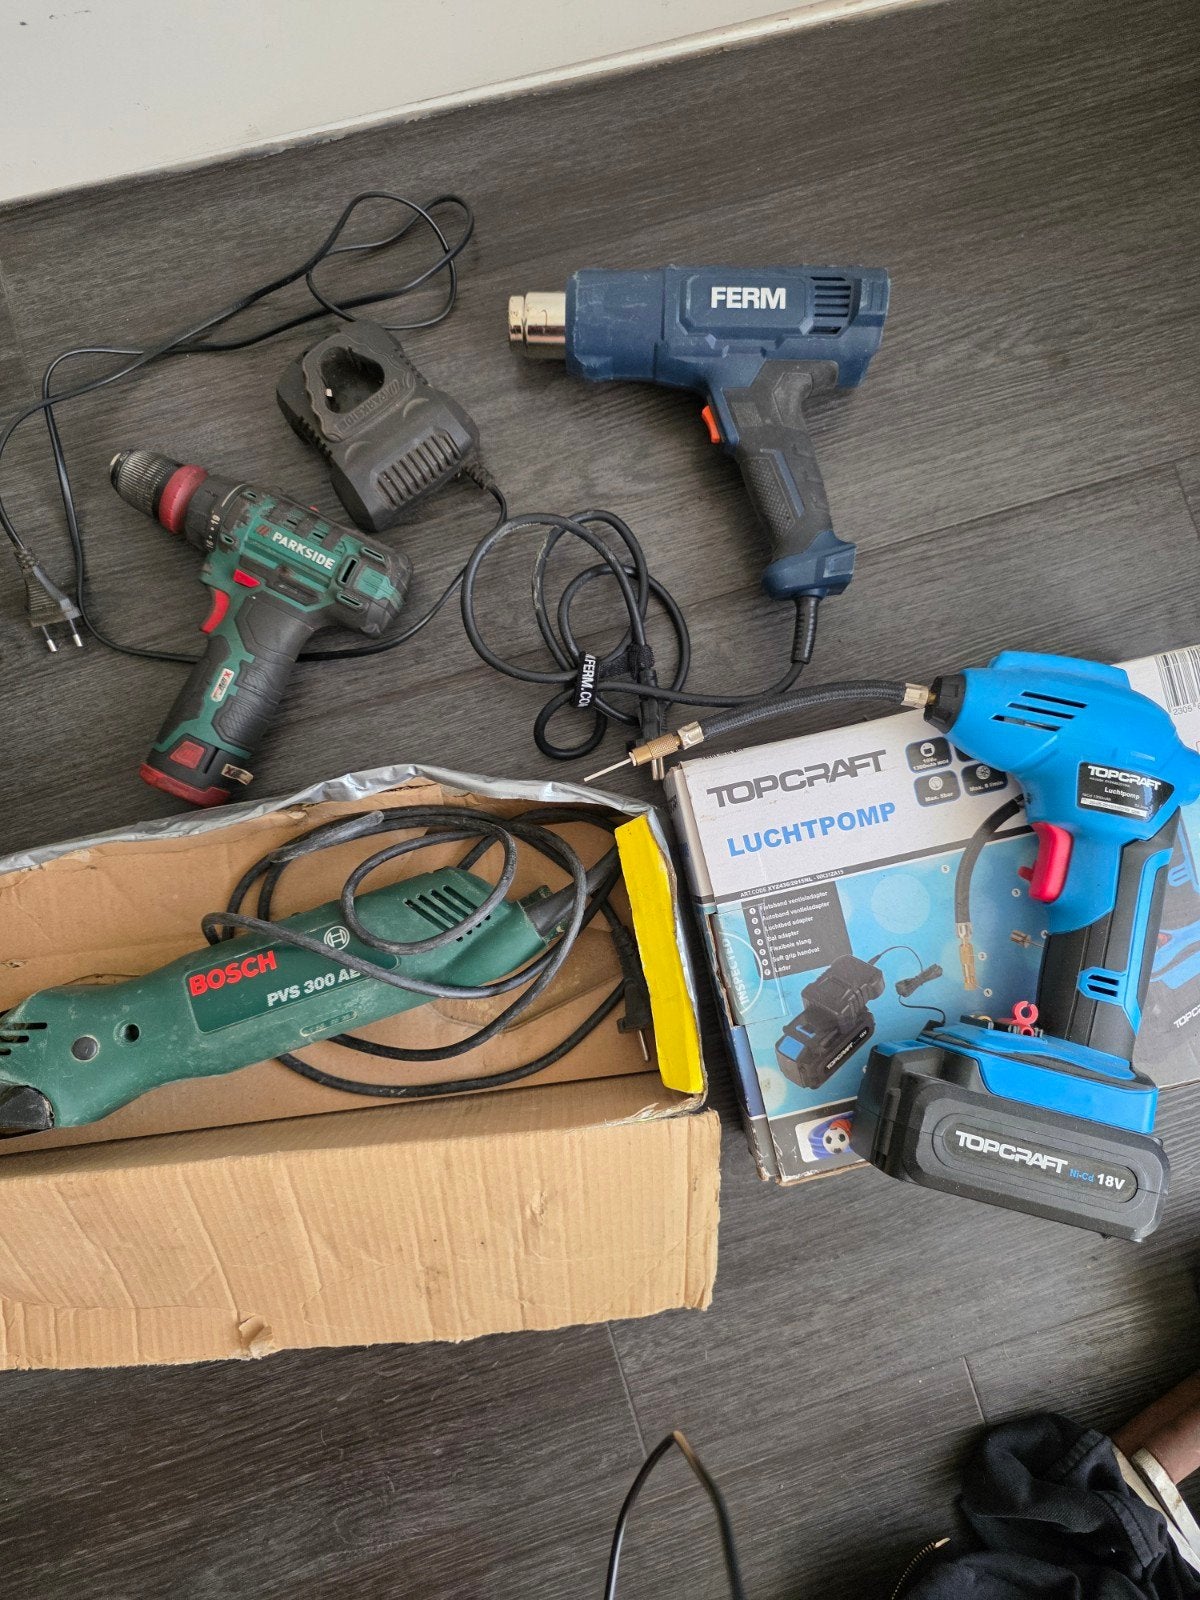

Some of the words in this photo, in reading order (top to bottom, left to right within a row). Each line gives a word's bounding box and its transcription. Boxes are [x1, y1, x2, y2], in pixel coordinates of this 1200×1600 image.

[711, 287, 786, 309] FERM
[272, 531, 336, 570] PARKSIDE
[706, 750, 886, 807] TOPCRAFT
[1087, 765, 1162, 791] TOPCRAFT
[1105, 787, 1140, 800] Luchtpomp
[727, 802, 895, 857] LUCHTPOMP
[188, 951, 278, 996] BOSCH
[267, 985, 300, 1006] PVS
[303, 973, 336, 994] 300
[1173, 1004, 1200, 1029] TOPC
[956, 1130, 1068, 1174] TOPCRAFT
[1069, 1168, 1095, 1183] Ni-Cd
[1097, 1173, 1126, 1190] 18V
